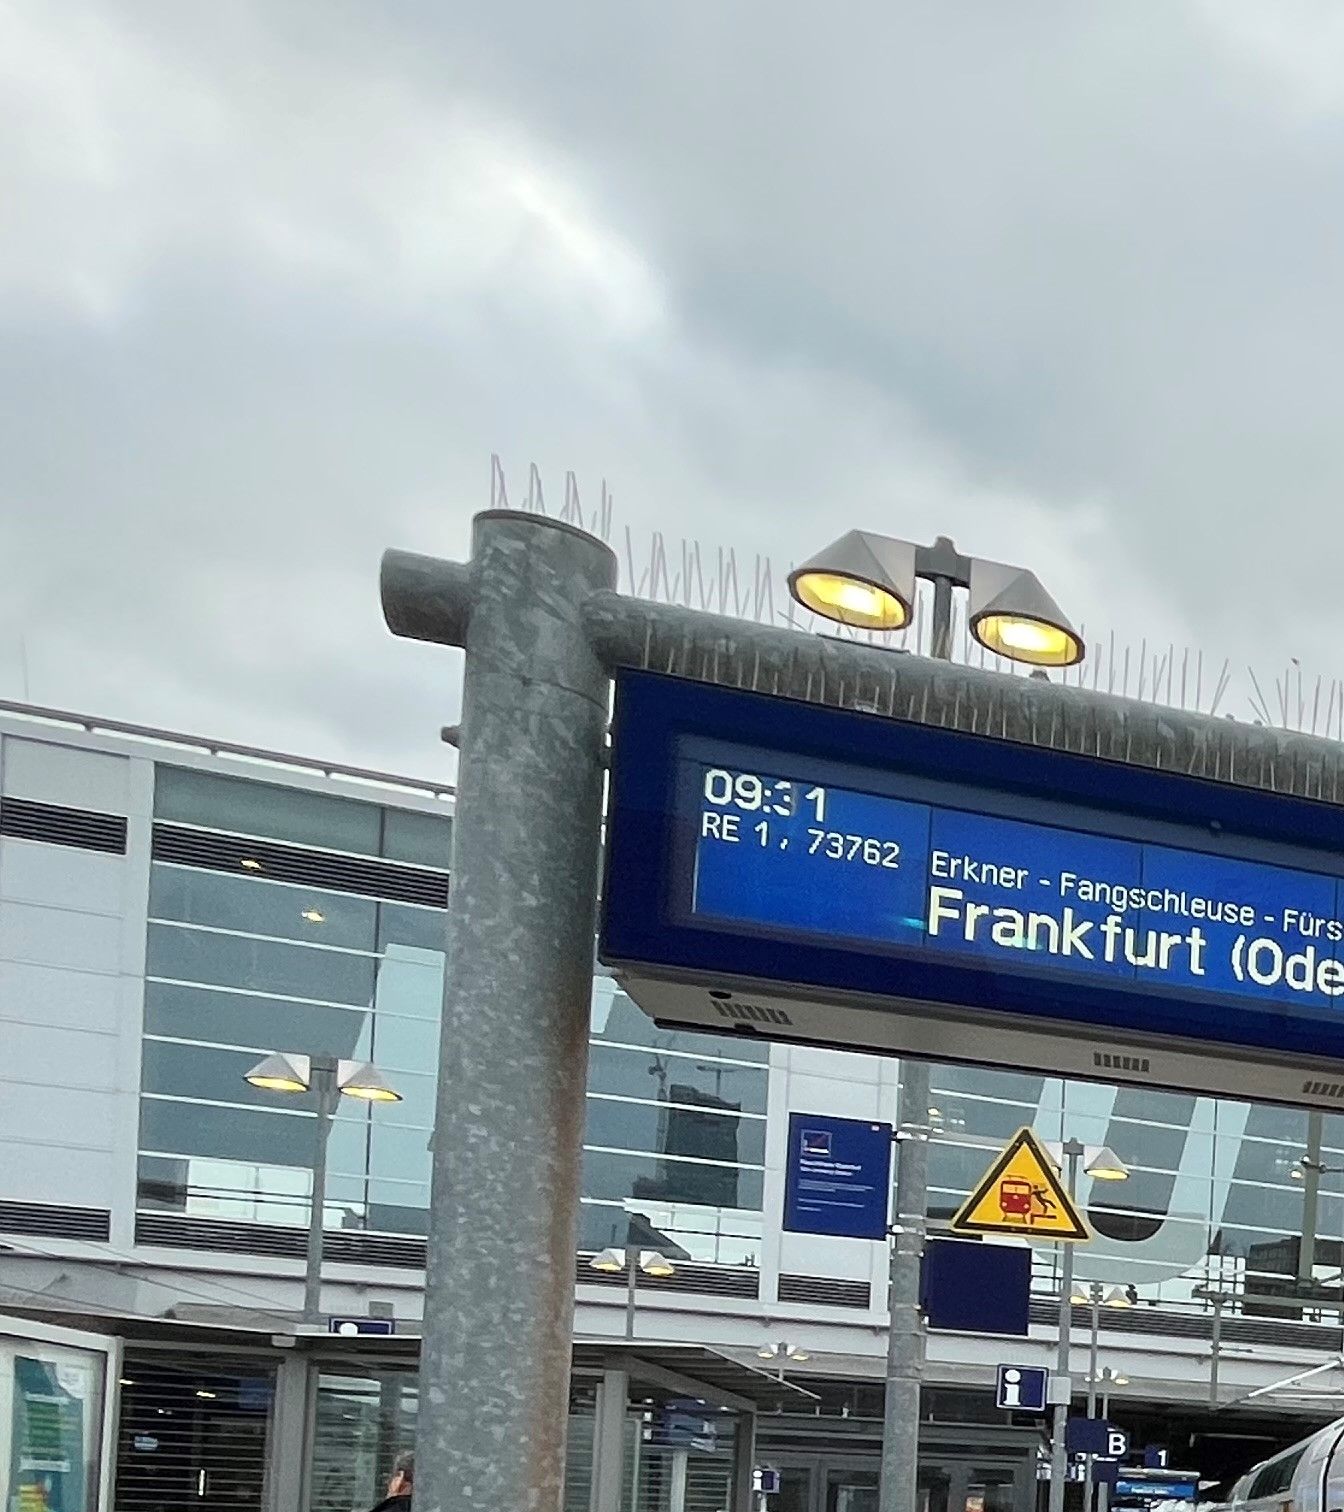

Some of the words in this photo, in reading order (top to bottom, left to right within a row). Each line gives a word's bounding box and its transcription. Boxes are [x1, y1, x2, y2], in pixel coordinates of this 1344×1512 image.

[702, 811, 741, 842] RE
[807, 827, 900, 869] 73762
[931, 850, 1029, 890] Erkner
[1060, 871, 1255, 926] Fangschleuse
[928, 885, 1207, 976] Frankfurt
[1108, 1432, 1126, 1456] B
[1157, 1449, 1167, 1467] 1
